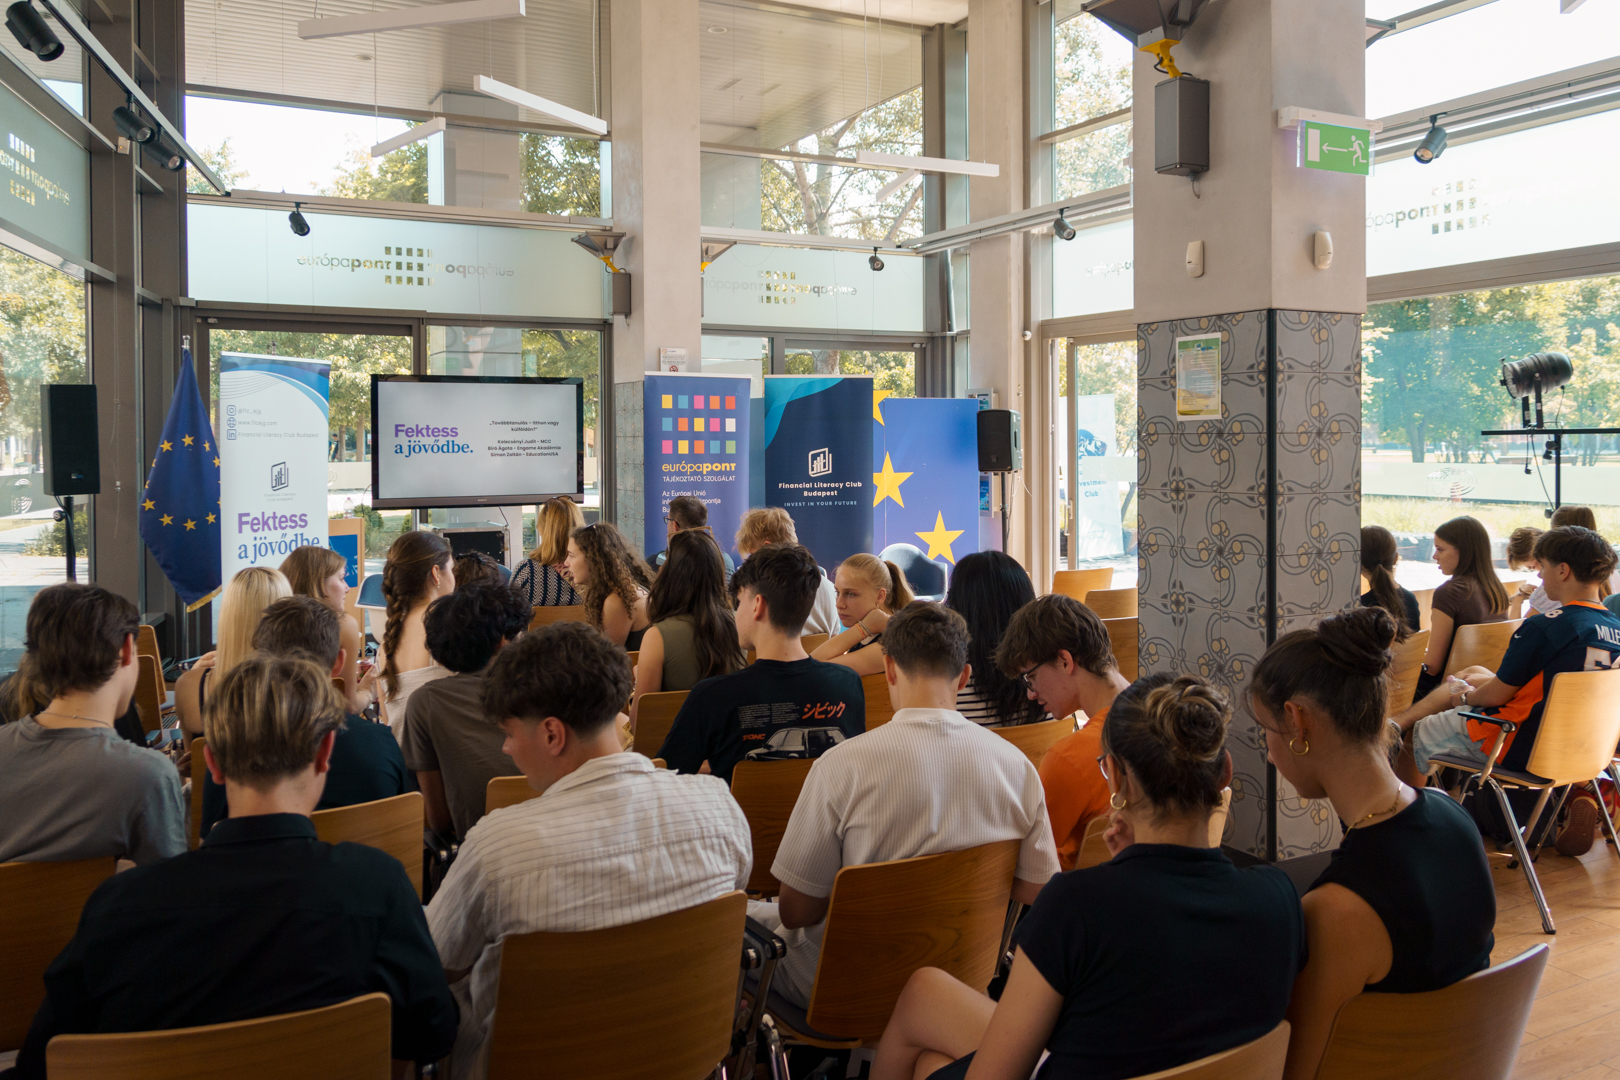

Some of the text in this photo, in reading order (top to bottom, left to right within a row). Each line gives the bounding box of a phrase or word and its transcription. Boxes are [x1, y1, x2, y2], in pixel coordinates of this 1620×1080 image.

[297, 253, 392, 272] európapont
[394, 424, 459, 438] Fektess
[394, 439, 474, 458] a jövődbe.
[662, 461, 736, 475] európapont
[803, 490, 838, 498] Budapest
[238, 511, 308, 534] Fektess
[238, 544, 249, 560] a
[802, 701, 845, 719] シビック
